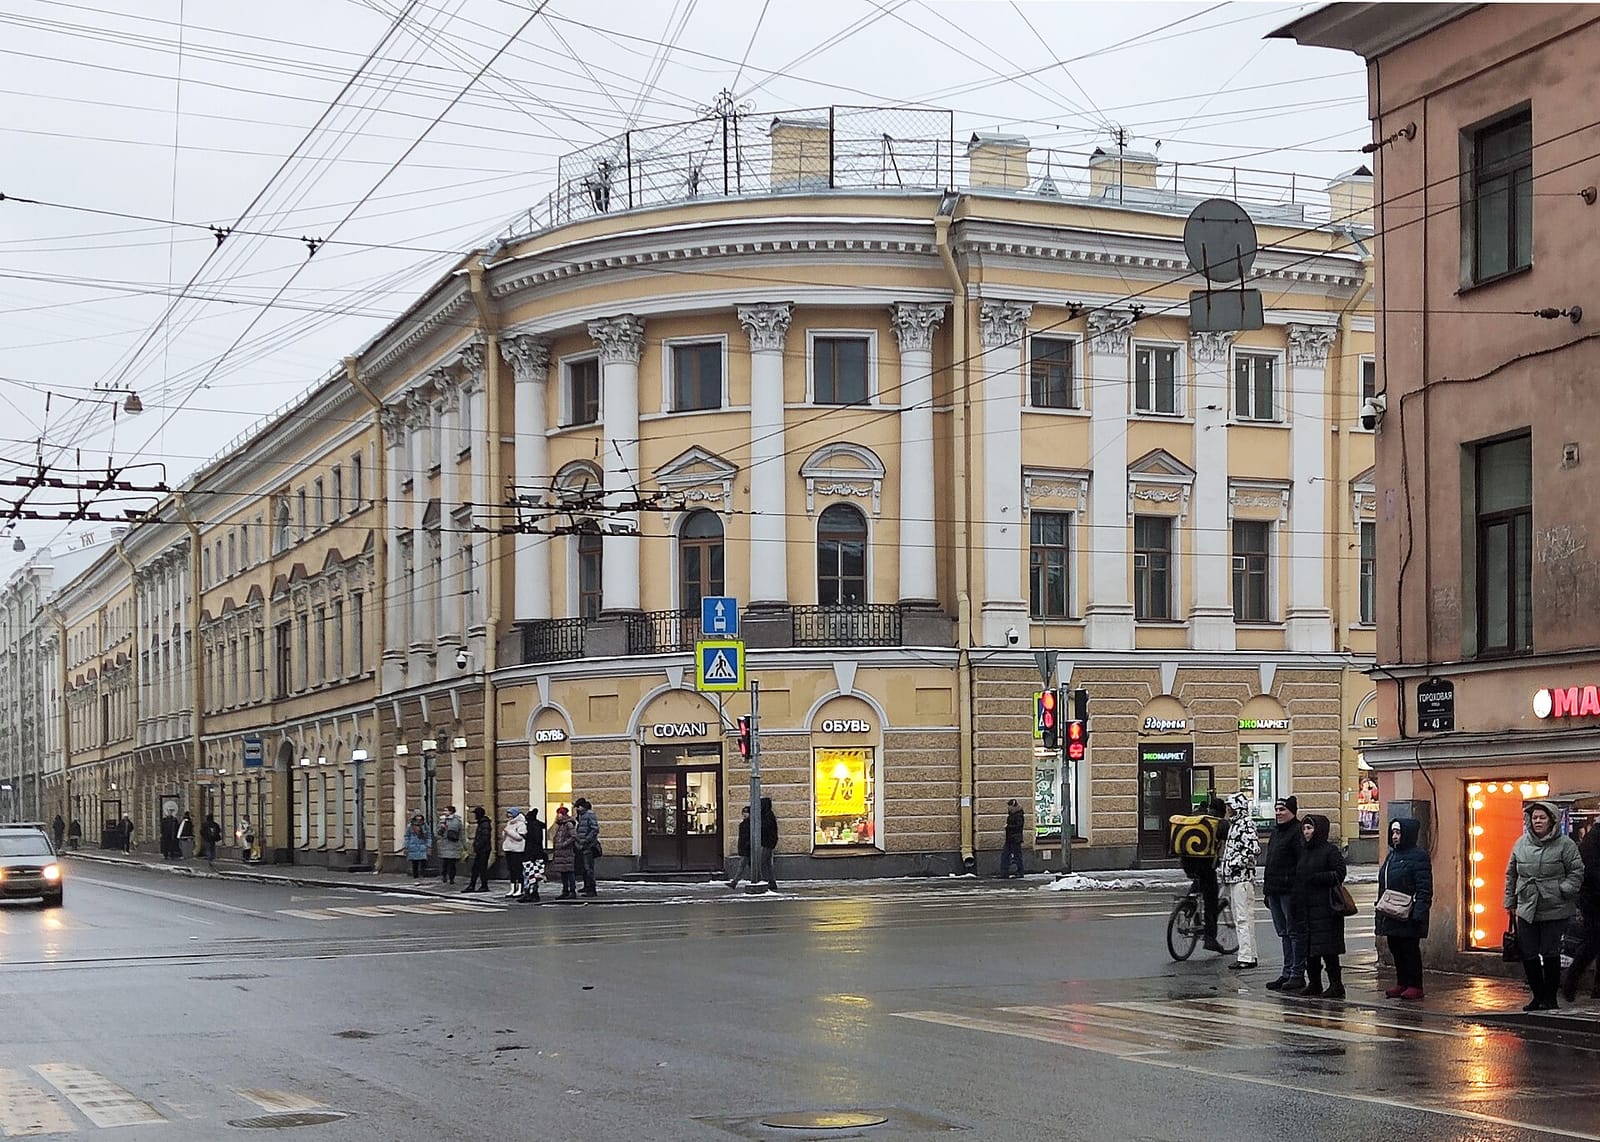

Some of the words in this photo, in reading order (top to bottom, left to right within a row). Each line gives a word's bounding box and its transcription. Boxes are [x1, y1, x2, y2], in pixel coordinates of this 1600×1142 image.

[1419, 691, 1452, 703] ГОРОХОВАЯ
[822, 719, 870, 732] ОБУВЬ
[1238, 719, 1290, 730] ЭКОМАРКЕТ
[1432, 718, 1440, 728] 43
[535, 729, 565, 742] ОБУВЬ
[653, 722, 707, 737] COVANI
[1143, 751, 1185, 760] ЭКОМАРКЕТ
